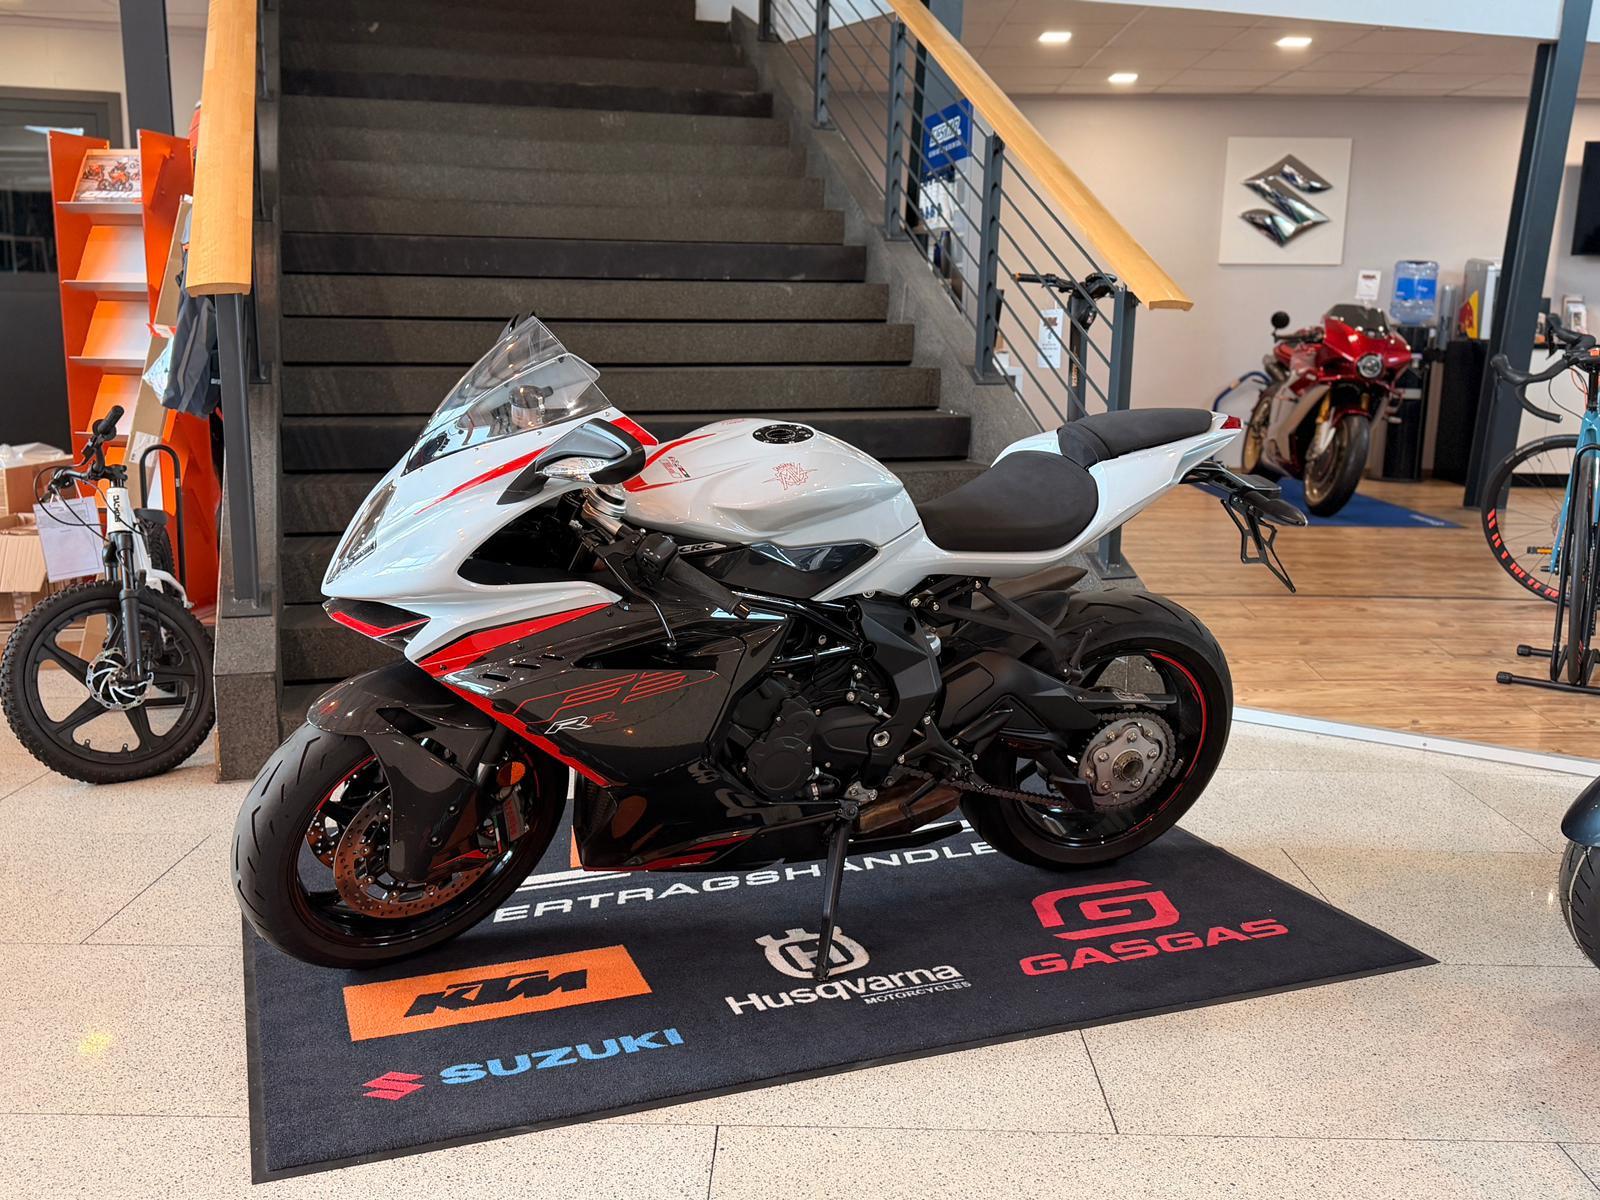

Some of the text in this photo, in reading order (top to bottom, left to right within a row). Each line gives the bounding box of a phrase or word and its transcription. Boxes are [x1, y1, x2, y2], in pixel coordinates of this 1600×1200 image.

[678, 542, 715, 553] CRC
[544, 711, 619, 735] RR
[493, 841, 998, 923] ERTRAGSHNDLE
[1018, 918, 1289, 977] GASGAS
[403, 968, 588, 1018] KTM
[724, 964, 964, 1016] Husqvarna
[863, 981, 972, 1005] MOTORCYCLES
[439, 1027, 685, 1085] SUZUKI
